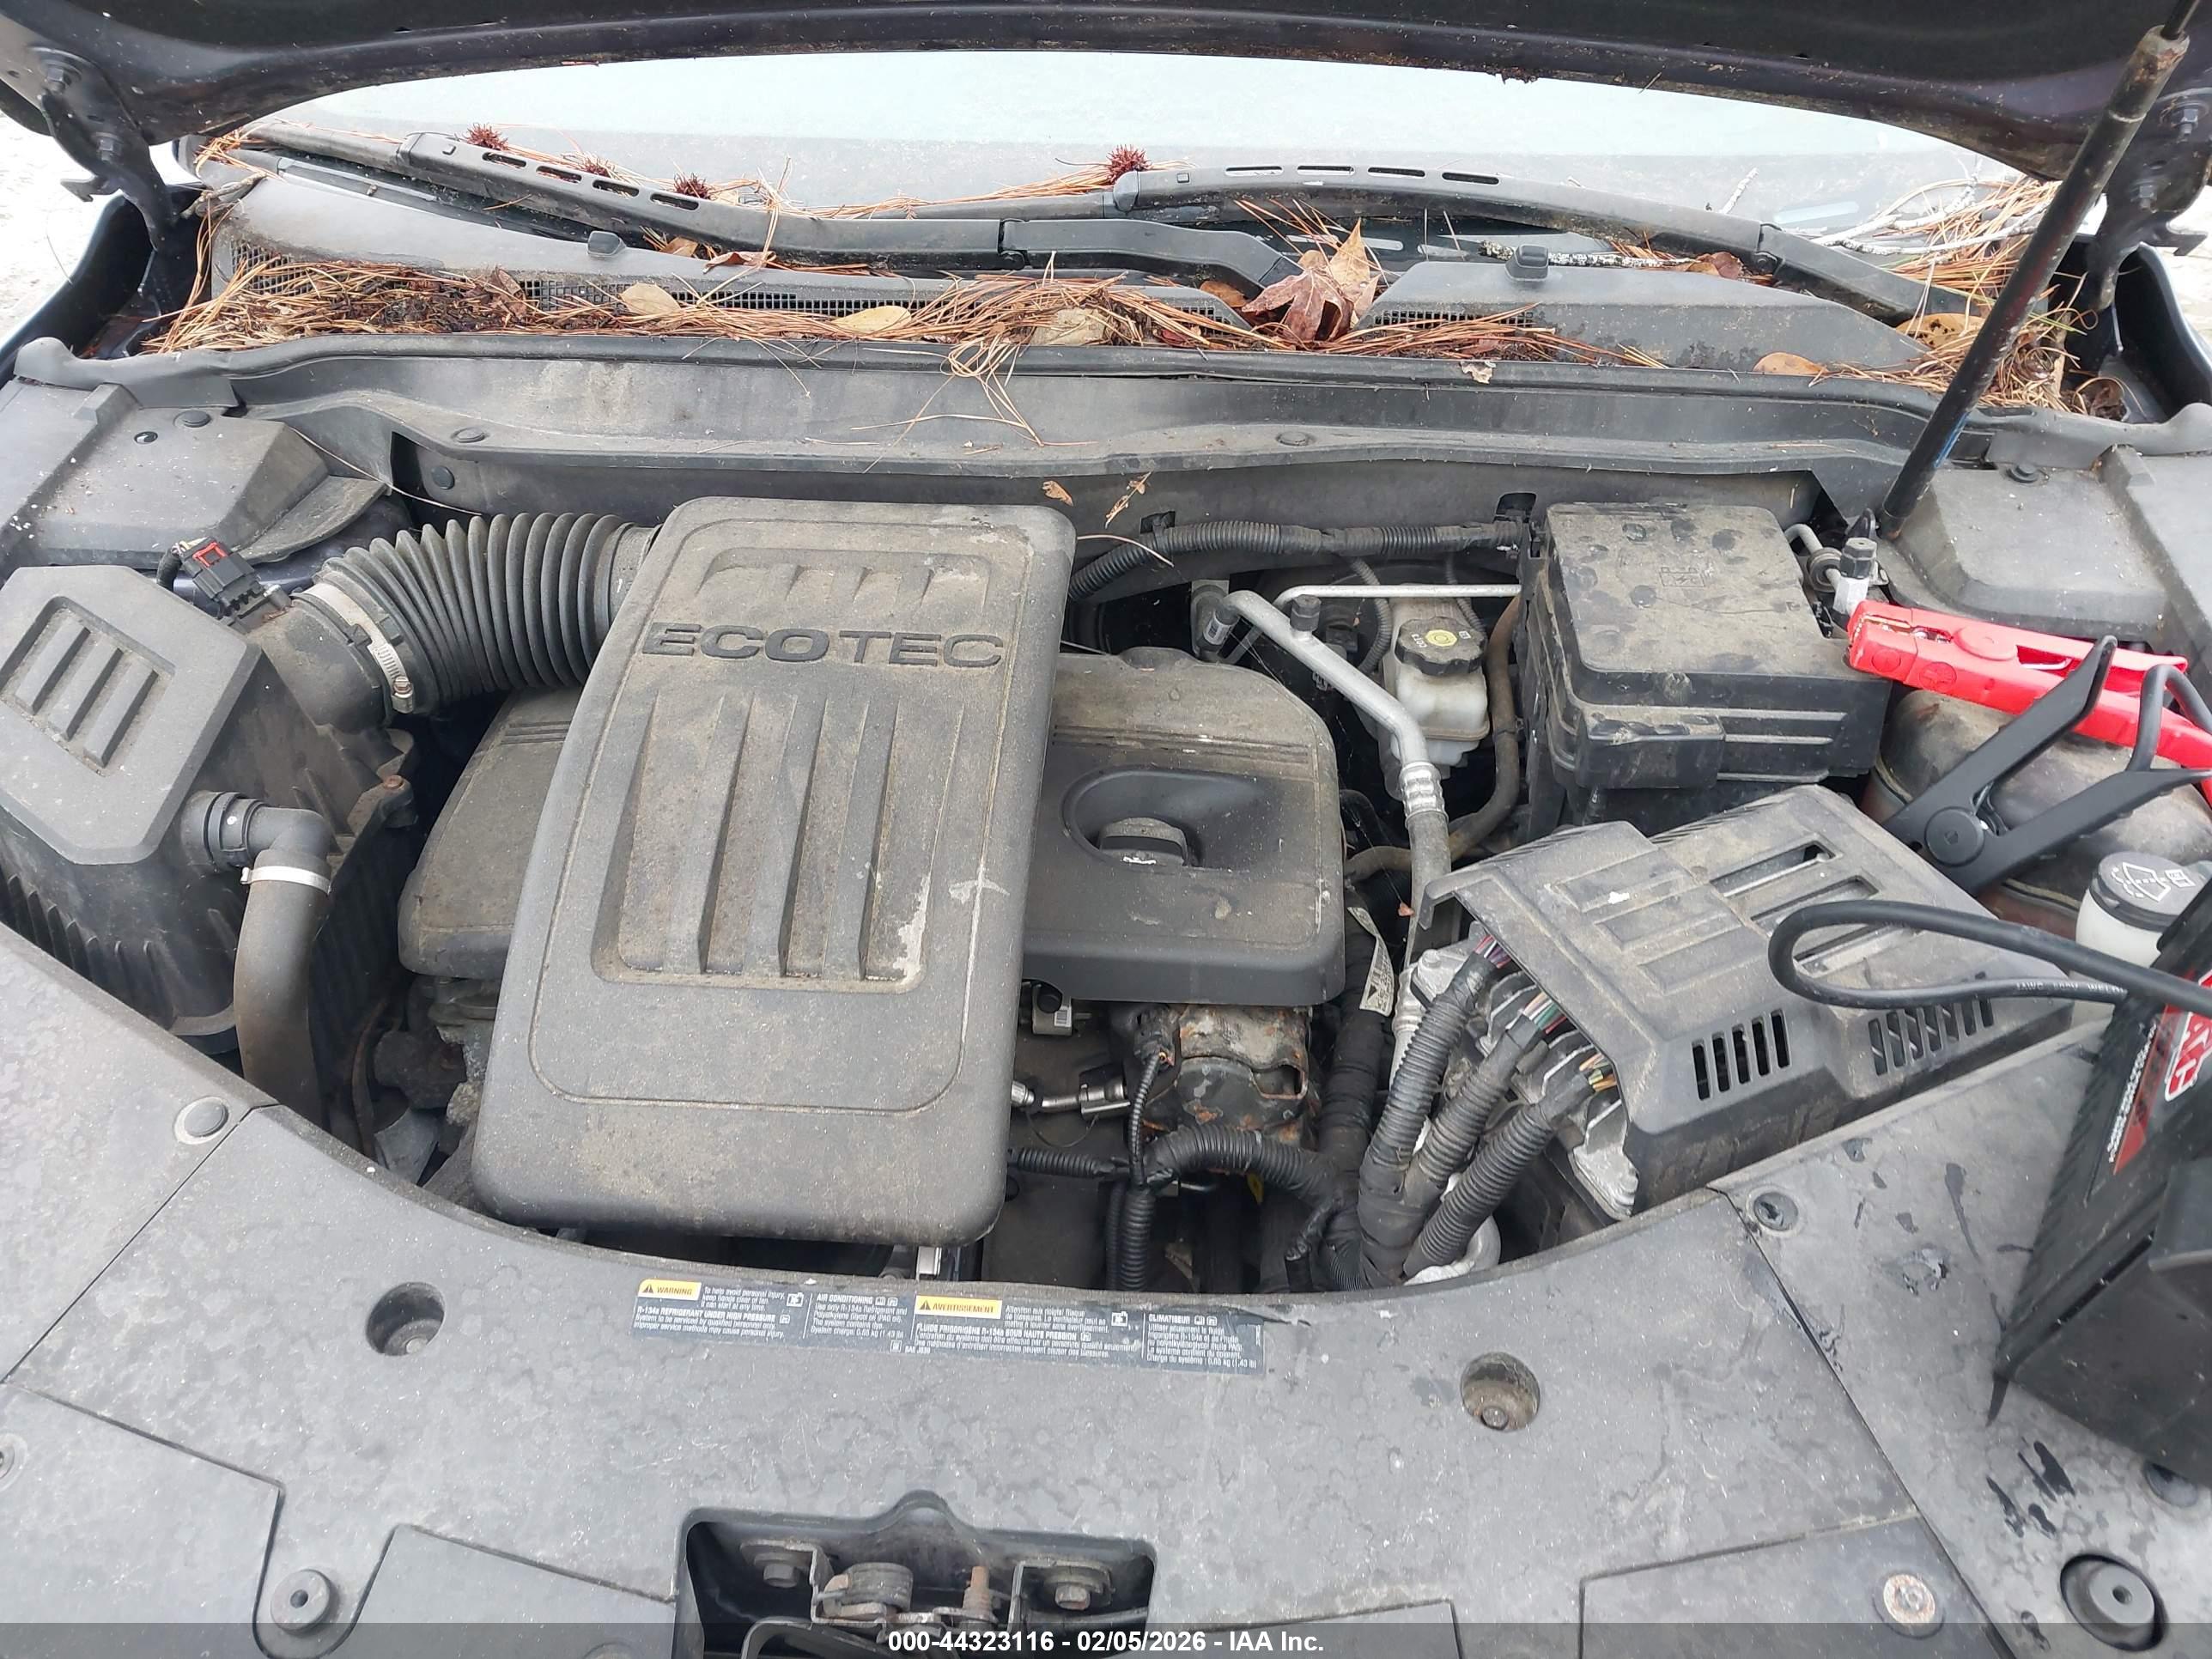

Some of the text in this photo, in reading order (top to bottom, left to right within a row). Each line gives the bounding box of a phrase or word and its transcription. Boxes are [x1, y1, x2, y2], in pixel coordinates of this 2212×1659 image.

[642, 622, 1004, 668] ECOTEC
[657, 1286, 693, 1295] WARNING
[829, 1294, 873, 1304] CONDITIONING
[933, 1303, 994, 1313] AVERTISSEMENT
[660, 1307, 702, 1317] REFRIGERANT
[743, 1313, 776, 1322] PRESSURE
[1149, 1314, 1190, 1324] CLIMATISEUR
[674, 1316, 698, 1324] serviced
[917, 1323, 938, 1332] FLUIDE
[1005, 1328, 1022, 1337] SOUS
[1024, 1330, 1044, 1339] HAUTE
[1046, 1332, 1077, 1341] PRESSION
